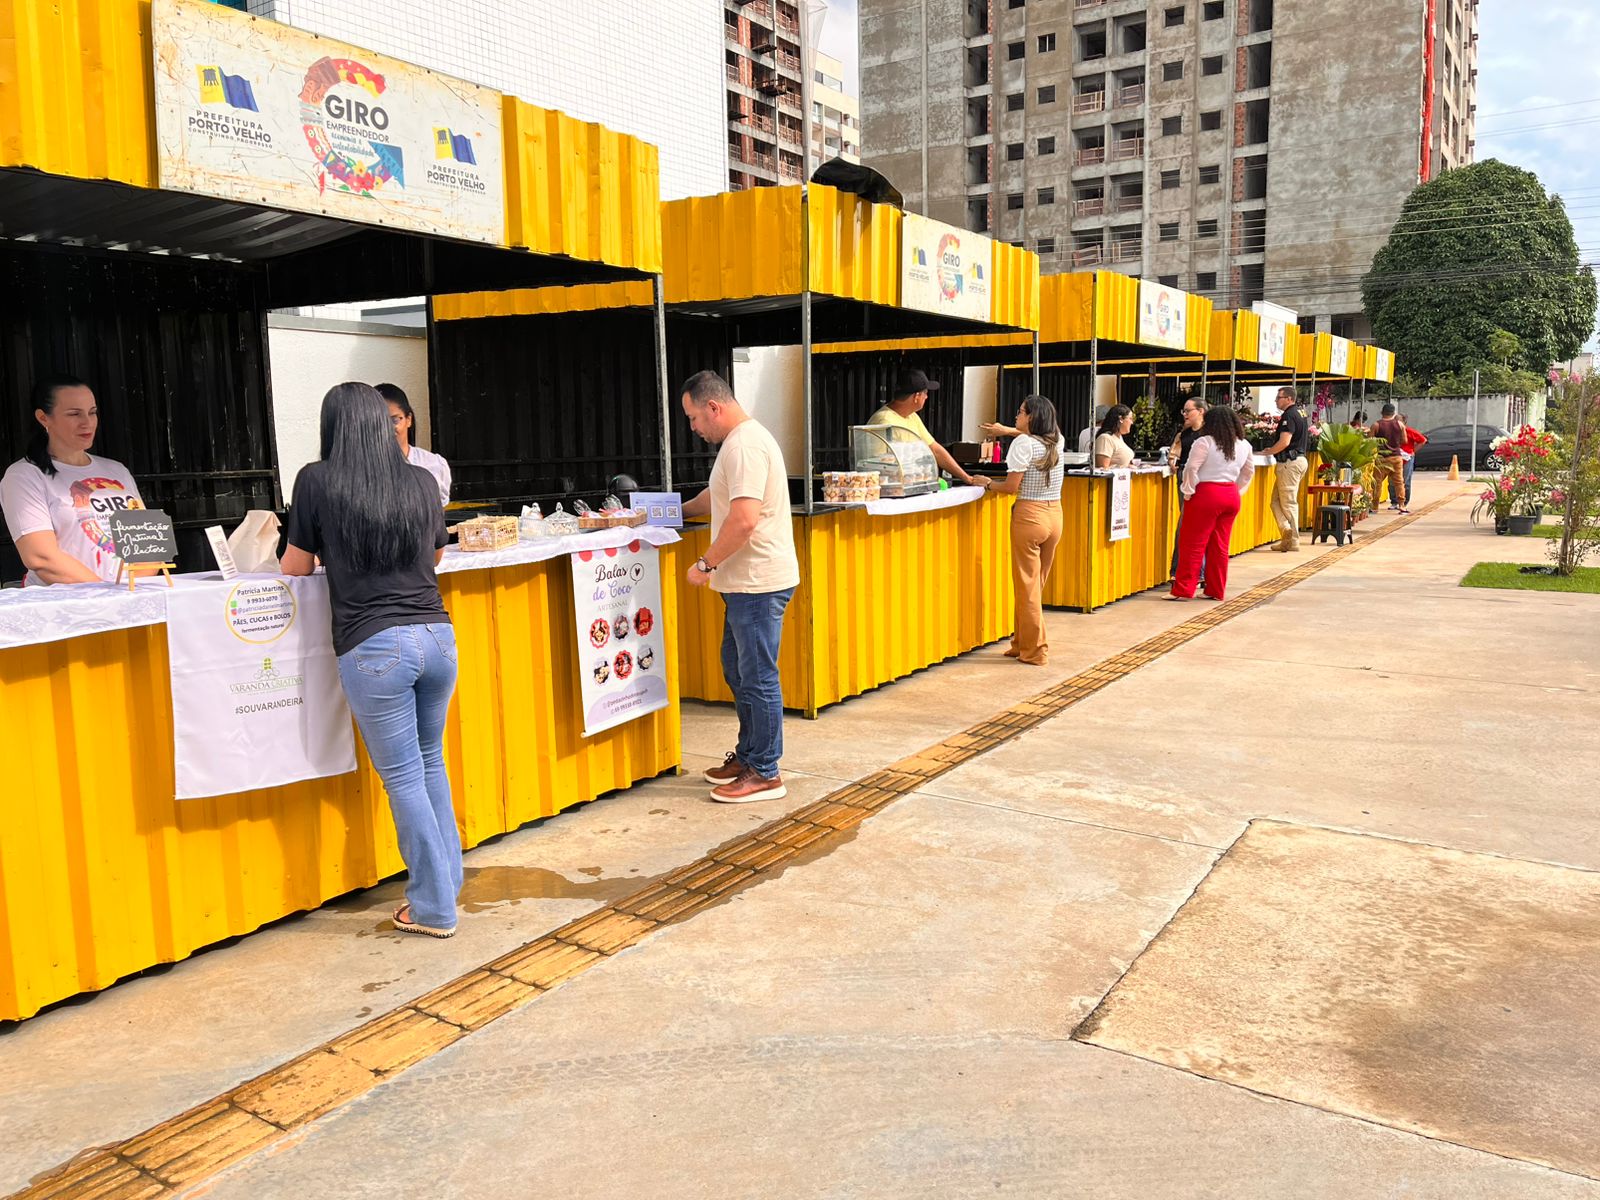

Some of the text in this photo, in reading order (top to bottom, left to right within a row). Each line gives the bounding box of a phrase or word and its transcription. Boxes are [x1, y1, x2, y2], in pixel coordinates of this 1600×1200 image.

[196, 110, 263, 130] PREFEITURA
[325, 94, 389, 130] GIRO
[188, 116, 272, 143] PORTO VELHO
[188, 127, 273, 149] CONSTRUINDO PROGRESSO
[326, 120, 390, 143] EMPREENDEDOR
[427, 170, 485, 191] PORTO VELHO
[432, 164, 479, 180] PREFEITURA
[943, 252, 960, 267] GIRO
[133, 544, 168, 555] lactose
[595, 563, 628, 582] Balas
[593, 580, 632, 601] de Coco
[598, 600, 628, 612] ARTESANAL
[233, 618, 249, 626] PÃES,
[249, 616, 269, 624] CUCAS
[274, 612, 291, 620] BOLOS
[242, 622, 285, 634] fermentação natural
[229, 681, 271, 693] VARANDA
[235, 696, 304, 714] #SOUVARANDEIRA
